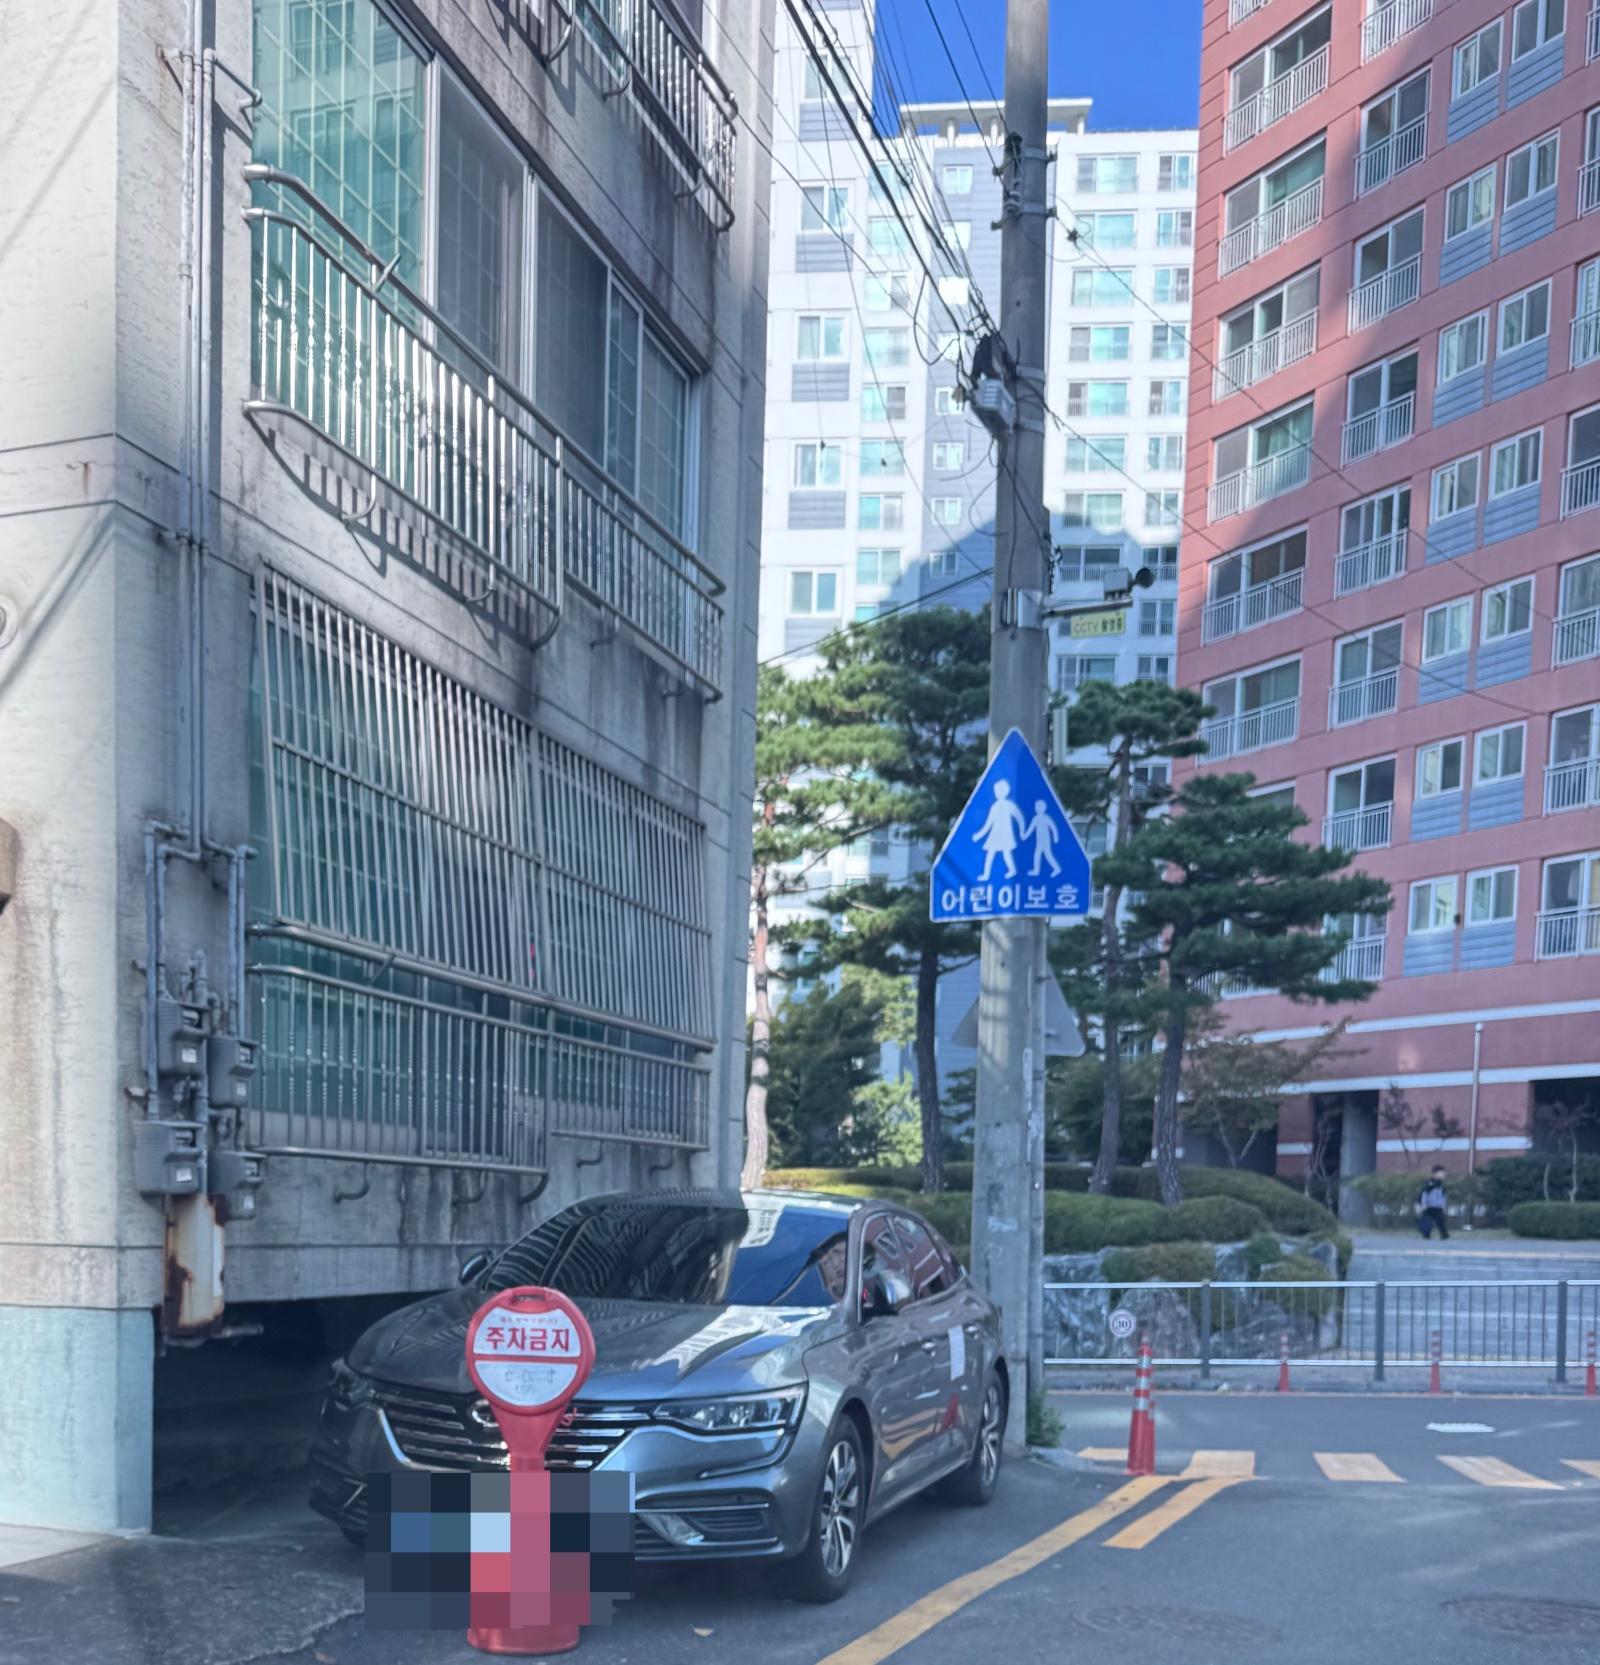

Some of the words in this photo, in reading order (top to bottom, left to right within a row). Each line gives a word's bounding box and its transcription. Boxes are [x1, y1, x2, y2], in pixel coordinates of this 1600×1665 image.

[1073, 620, 1099, 635] CCTV
[941, 883, 1080, 914] 어린이보호
[485, 1326, 570, 1353] 주차금지
